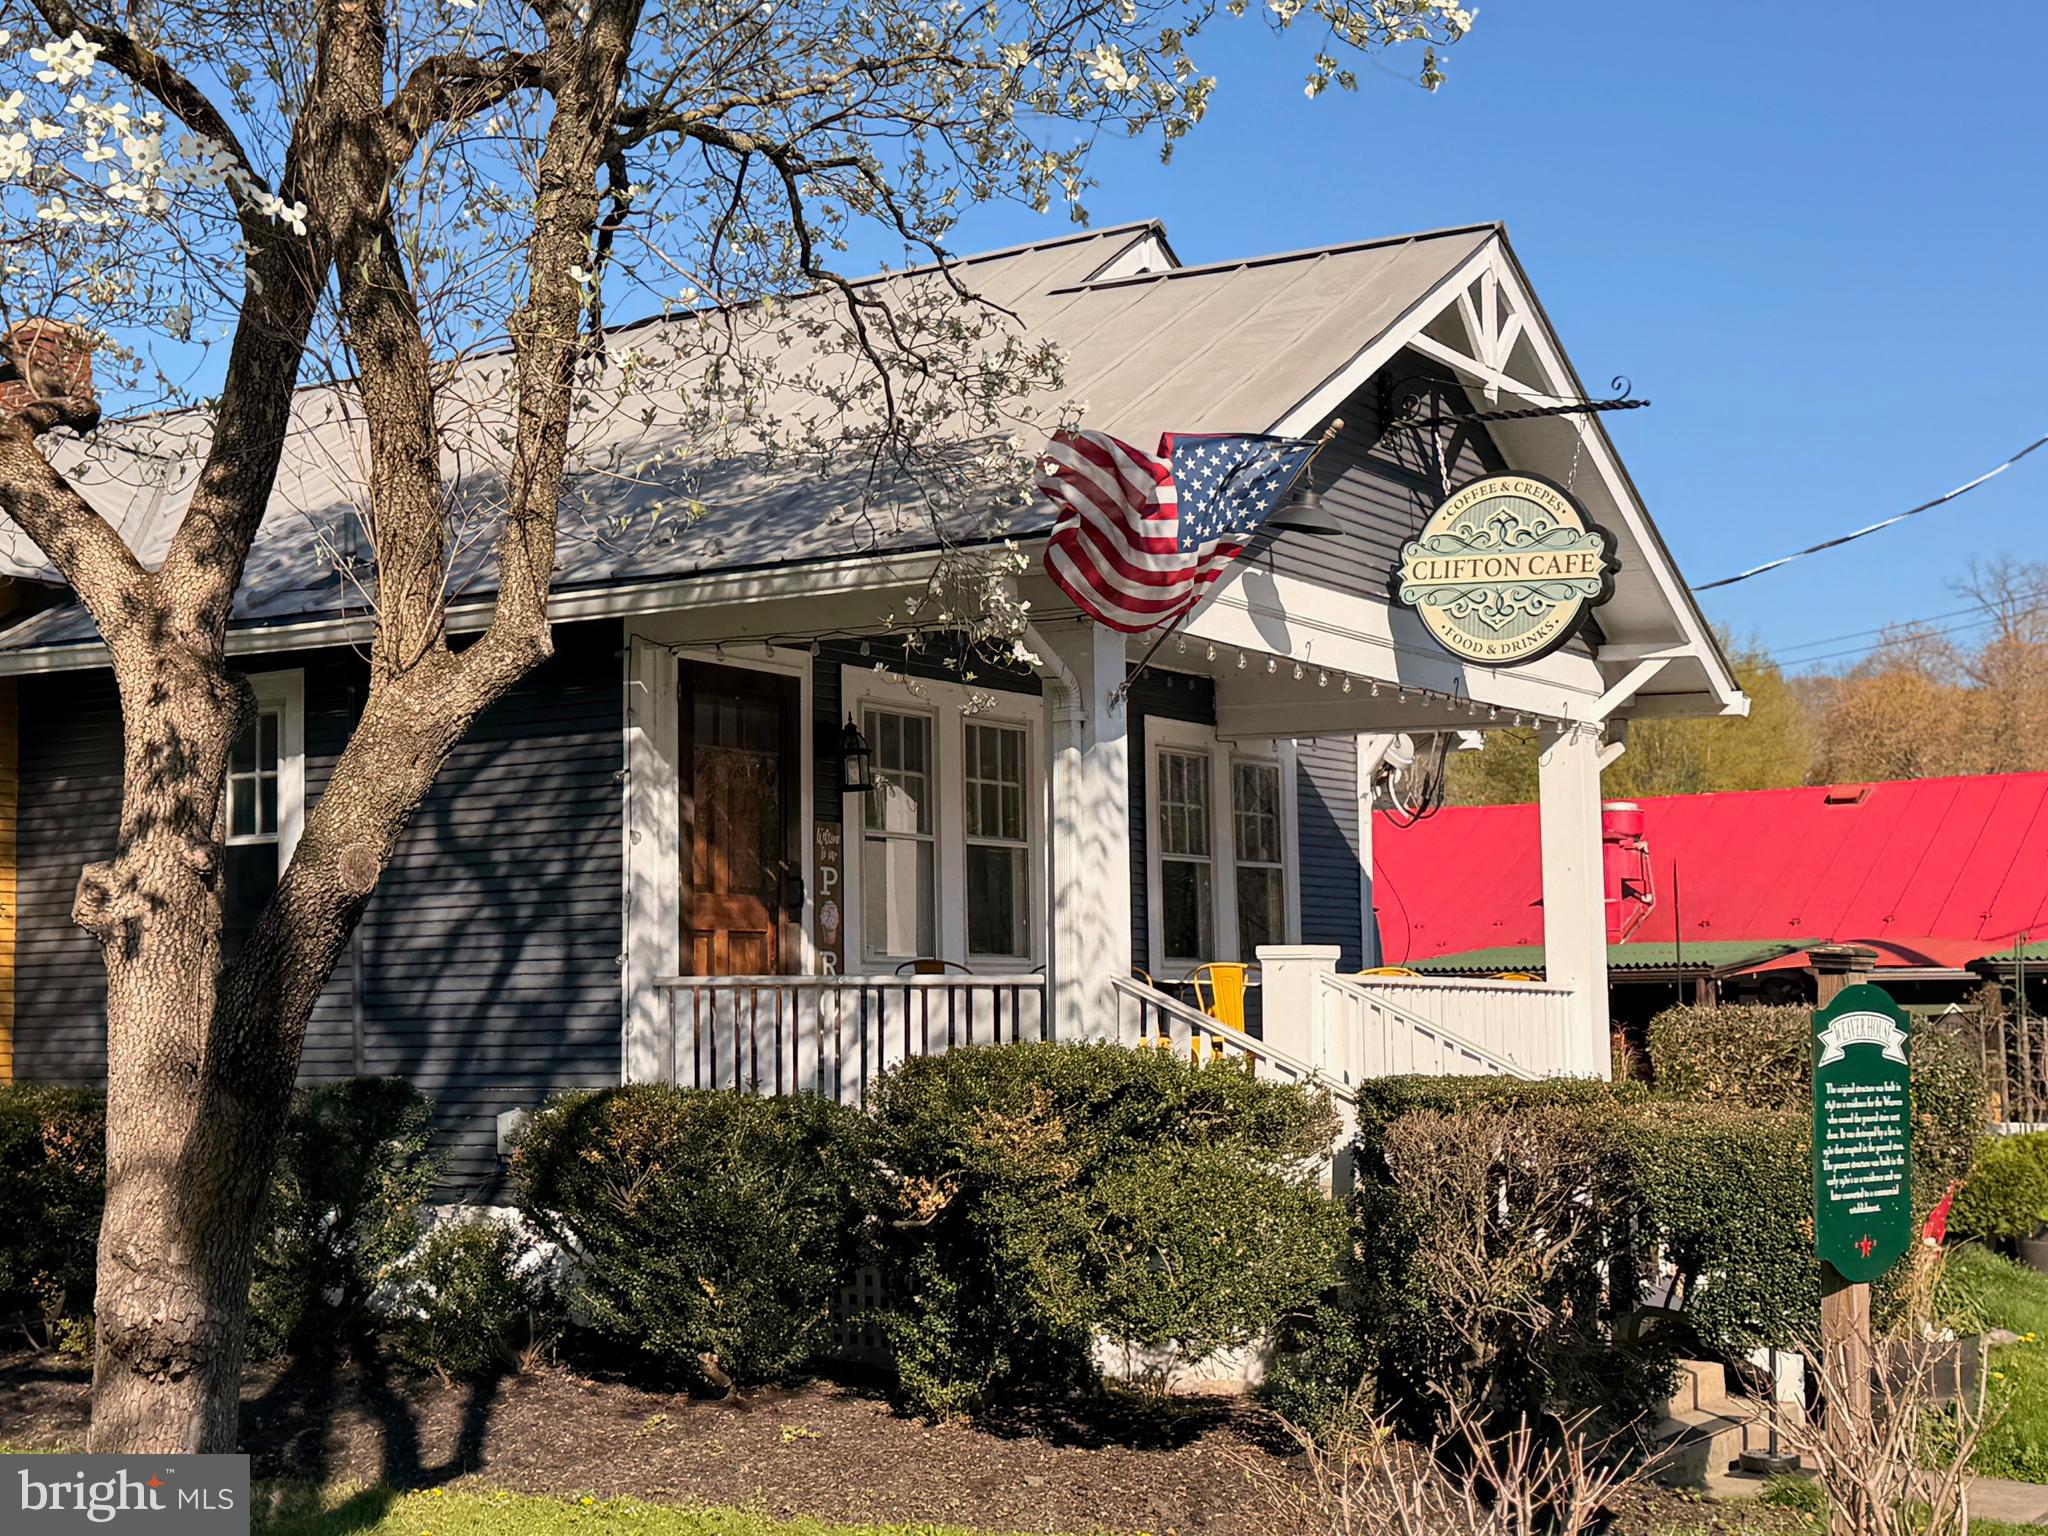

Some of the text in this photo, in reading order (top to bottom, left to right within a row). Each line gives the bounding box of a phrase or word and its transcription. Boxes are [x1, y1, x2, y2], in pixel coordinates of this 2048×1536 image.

[1446, 480, 1565, 517] COFFEE & CREPES
[1412, 552, 1596, 582] CLIFTON CAFE
[1444, 619, 1555, 656] FOOD & DRINKS
[1833, 1017, 1892, 1043] WEAVER HOUSE
